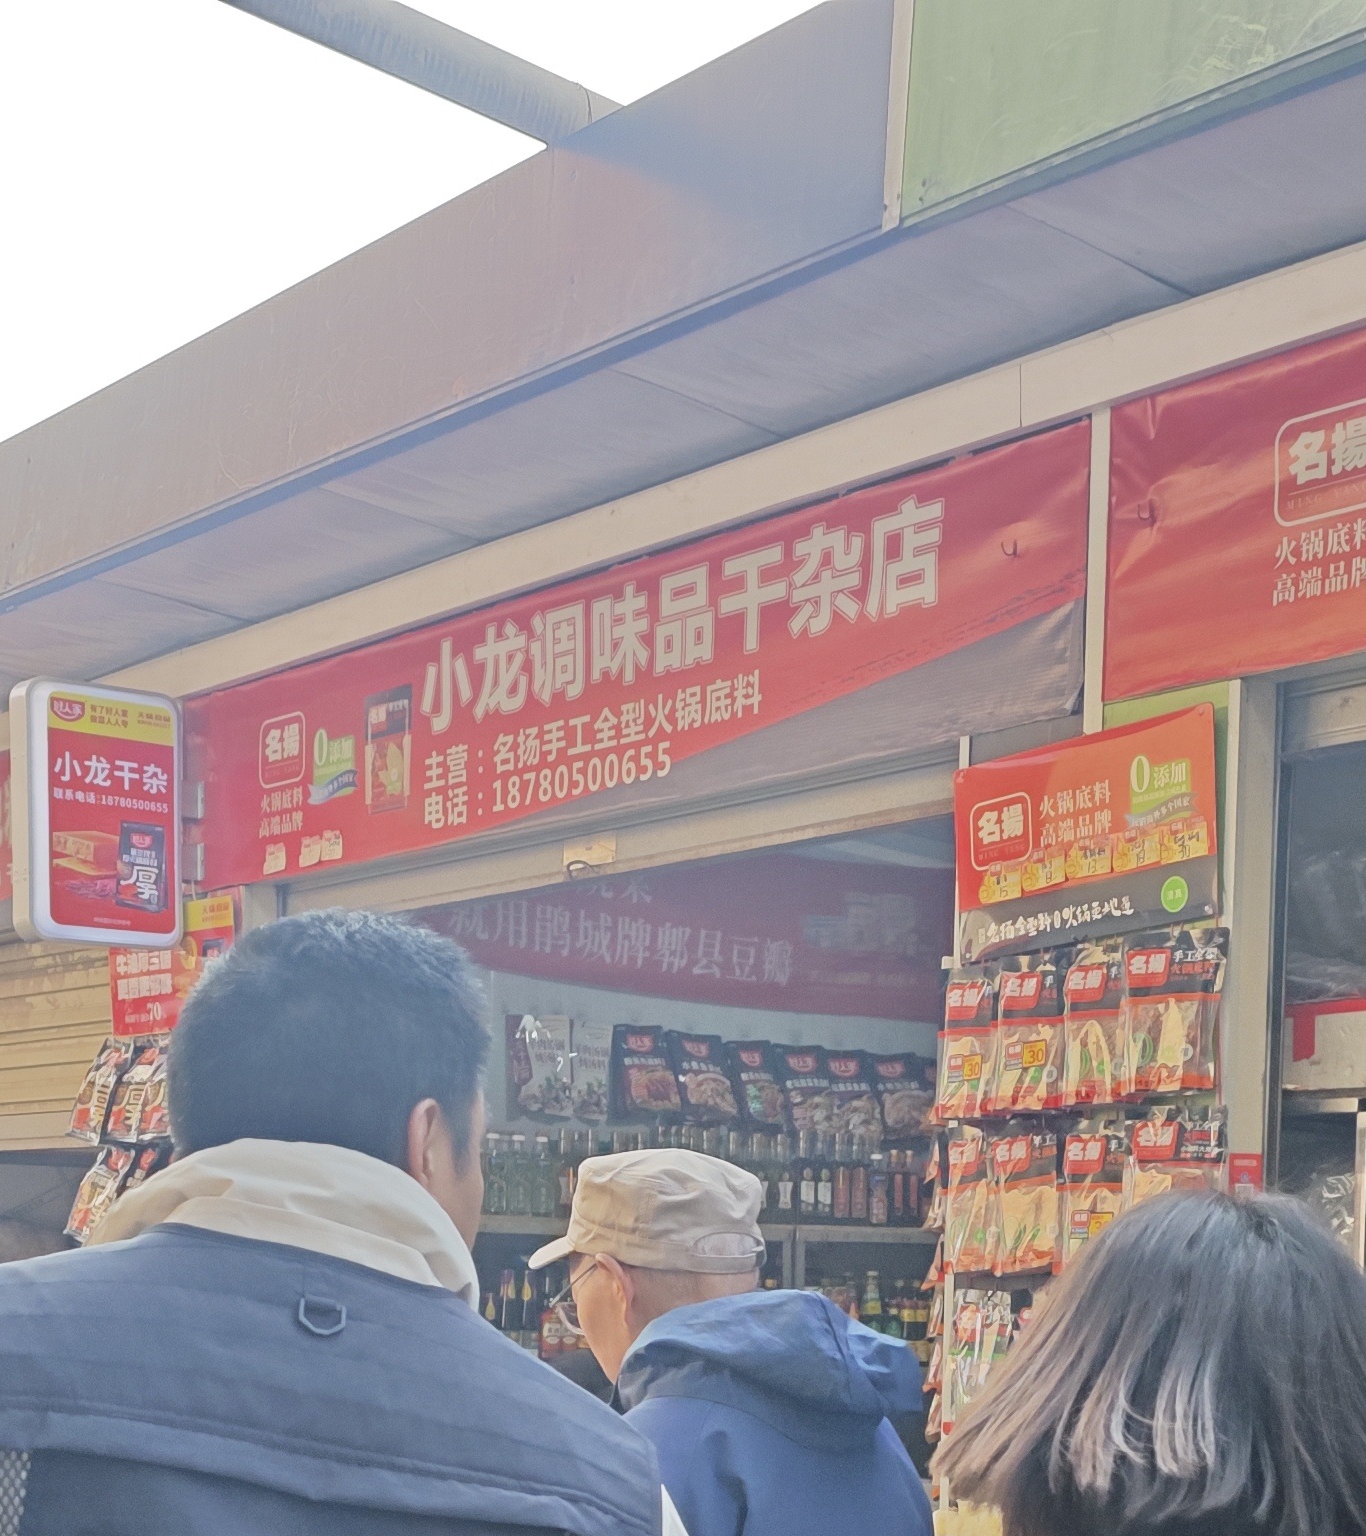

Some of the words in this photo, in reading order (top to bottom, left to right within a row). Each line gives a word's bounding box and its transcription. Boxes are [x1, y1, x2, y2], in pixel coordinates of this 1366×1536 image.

[420, 495, 946, 736] 小龙调味品干杂店
[423, 669, 762, 790] 主营：名扬手工全型火锅底料
[53, 751, 168, 795] 小龙干杂
[424, 741, 672, 830] 电话：18780500655
[260, 786, 304, 814] 火锅底料
[1039, 779, 1111, 821] 火锅底料
[259, 810, 304, 840] 高端品牌
[1040, 809, 1112, 849] 高端品牌
